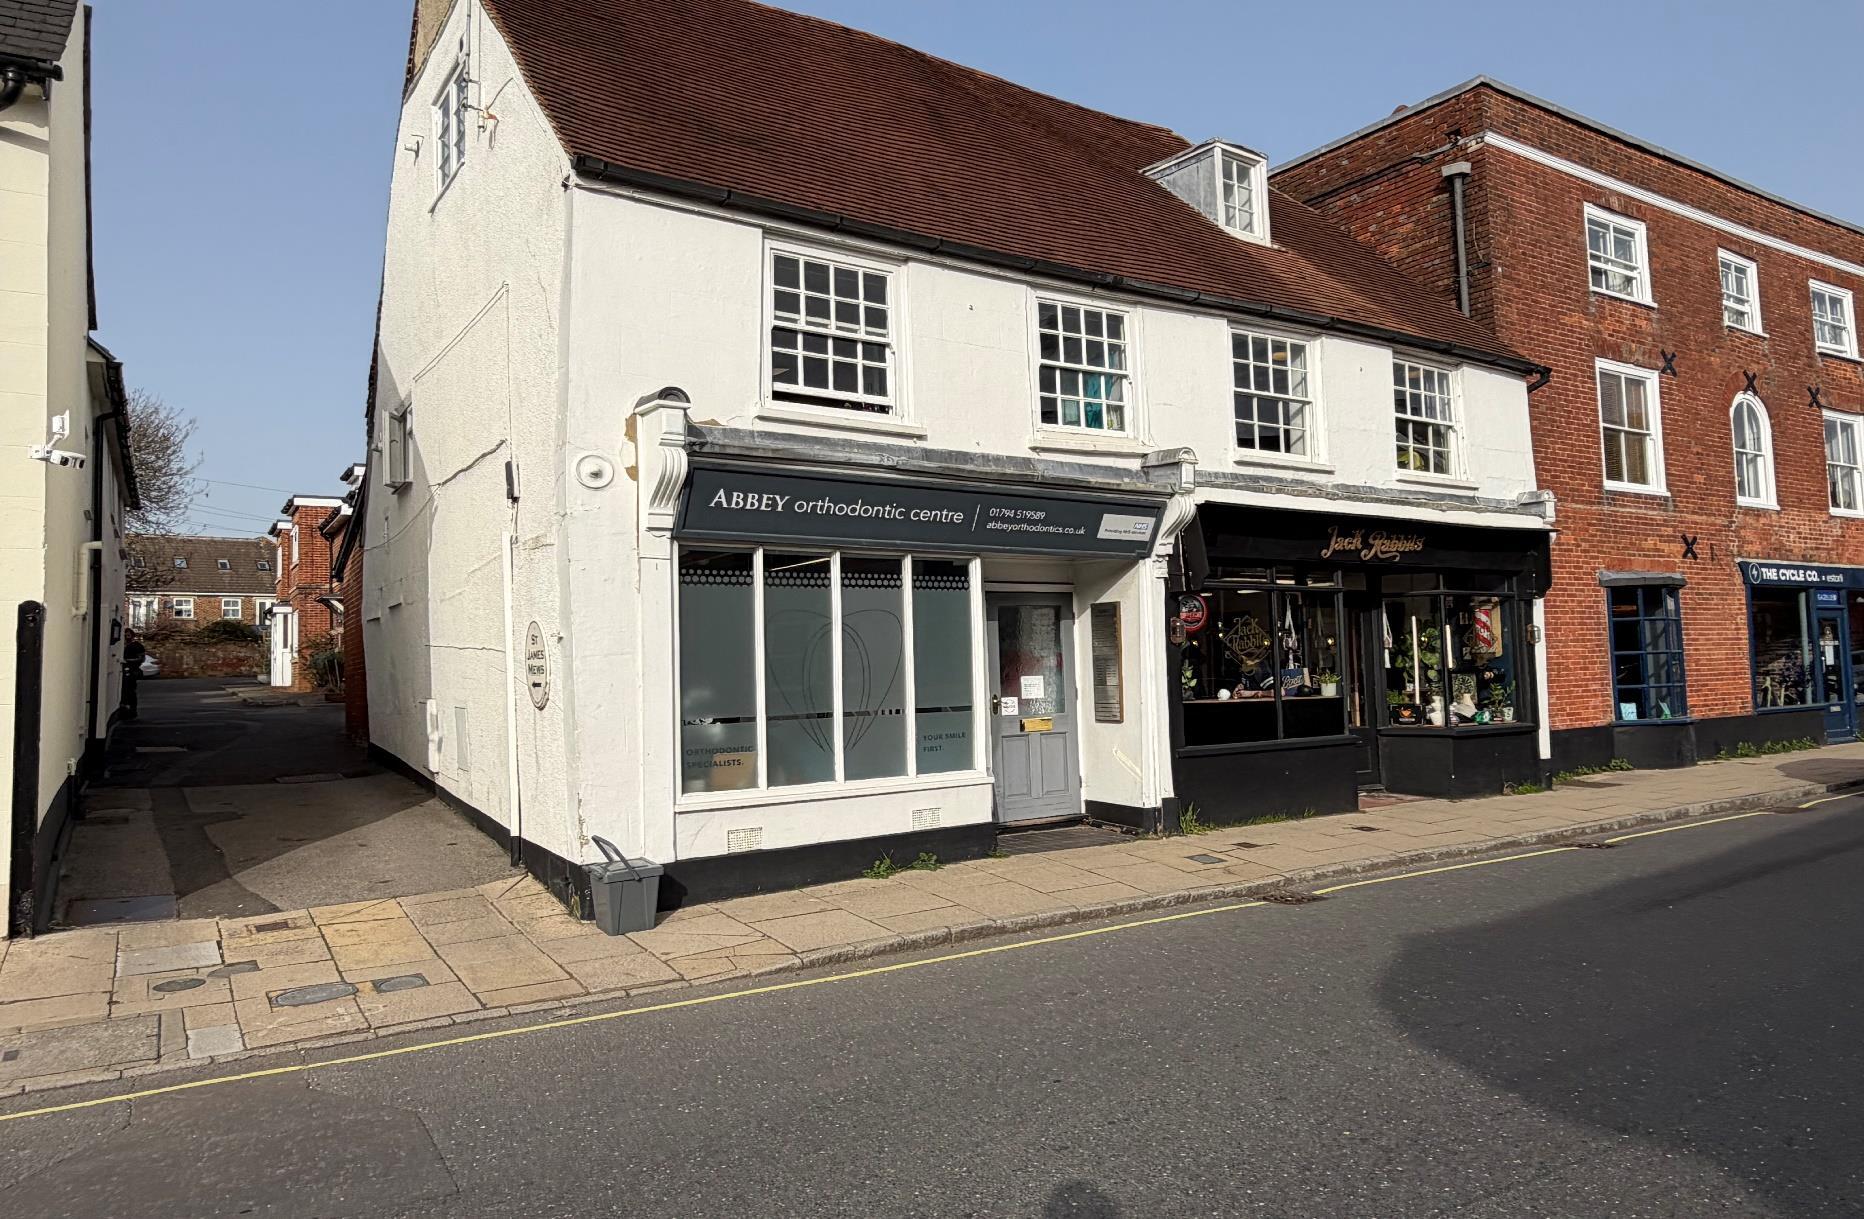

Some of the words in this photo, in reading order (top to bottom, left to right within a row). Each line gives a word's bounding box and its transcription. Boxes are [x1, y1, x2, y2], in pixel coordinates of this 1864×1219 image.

[708, 488, 791, 512] ABBEY
[794, 497, 906, 520] orthodontic
[910, 508, 964, 523] centre
[989, 507, 1015, 519] 01794
[1016, 509, 1046, 520] 519589
[986, 521, 1086, 535] abbeyorthodontics.co.uk
[1321, 525, 1365, 559] Jack
[1361, 530, 1425, 561] Rabbits
[1761, 567, 1778, 580] THE
[1780, 568, 1805, 581] CYCLE
[1806, 570, 1820, 582] CO.
[1234, 617, 1259, 637] Jack
[531, 634, 538, 645] ST
[527, 649, 544, 660] JAMES
[528, 663, 545, 675] MEWS
[686, 745, 753, 756] ORTHODONTIC
[686, 758, 744, 769] SPECIALISTS.
